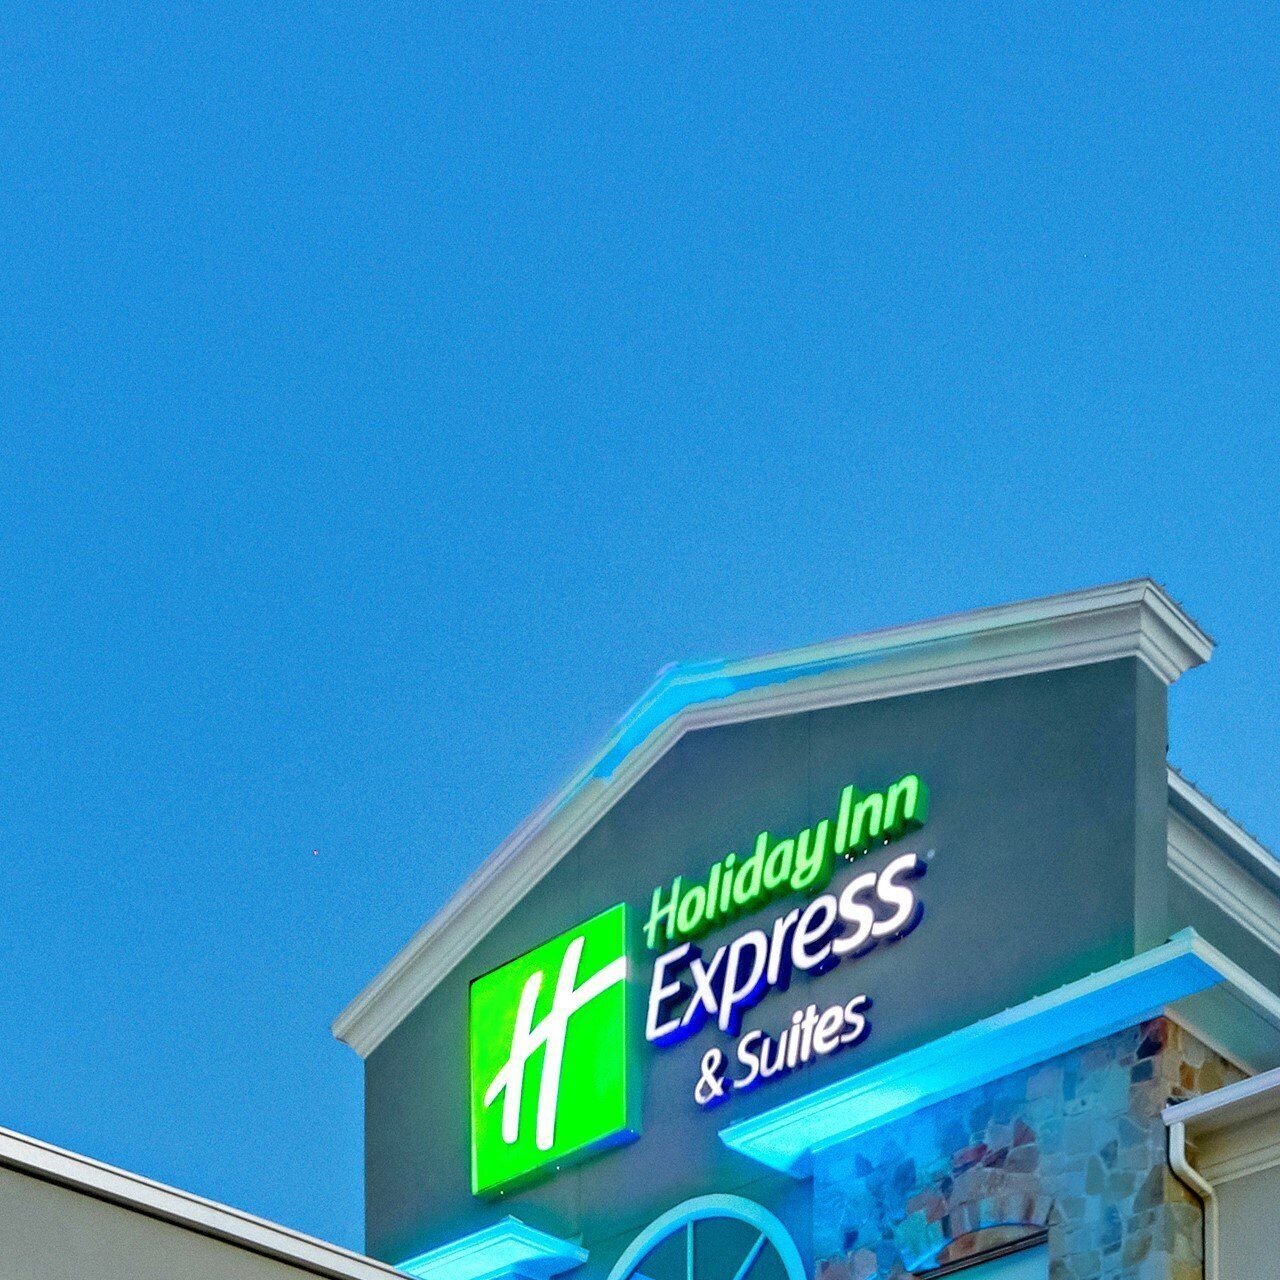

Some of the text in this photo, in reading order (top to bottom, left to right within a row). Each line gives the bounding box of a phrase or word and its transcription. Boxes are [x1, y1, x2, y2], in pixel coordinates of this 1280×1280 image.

[643, 774, 921, 948] Holiday Inn
[645, 853, 919, 1042] Express
[694, 995, 869, 1105] & Suites
